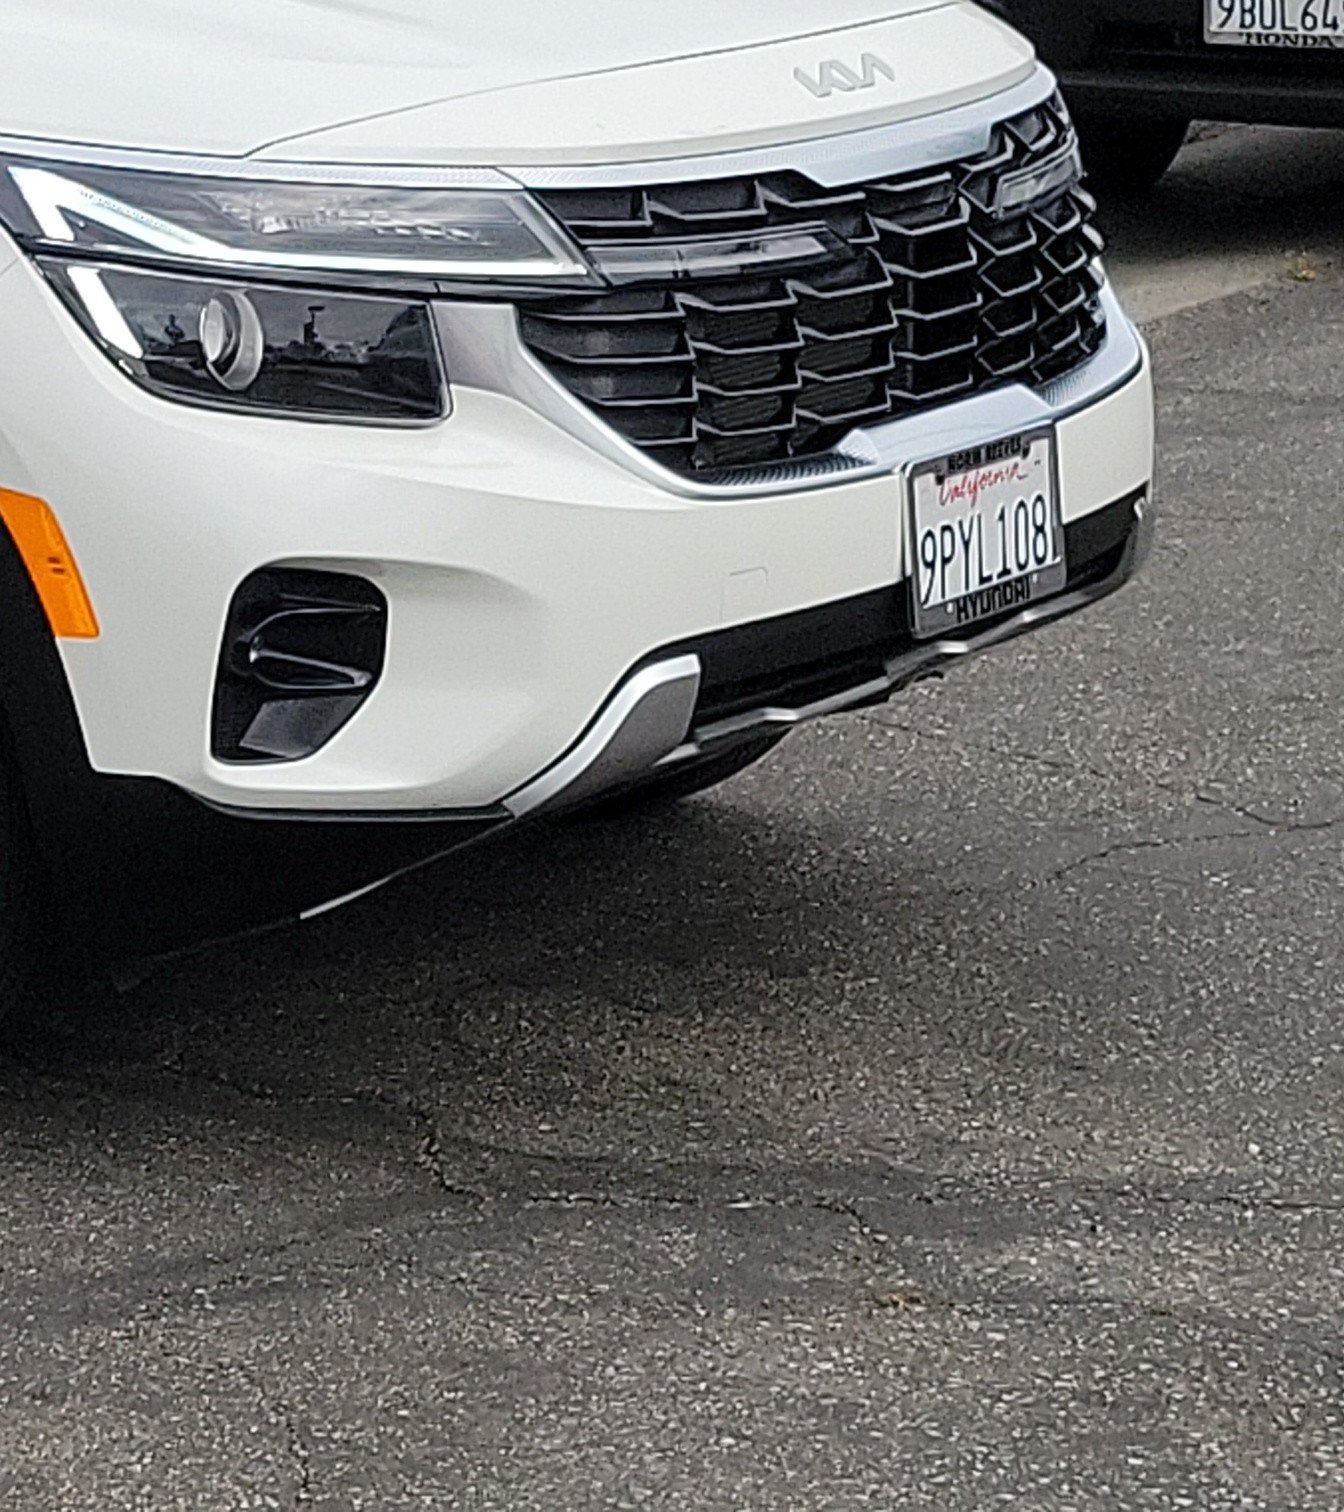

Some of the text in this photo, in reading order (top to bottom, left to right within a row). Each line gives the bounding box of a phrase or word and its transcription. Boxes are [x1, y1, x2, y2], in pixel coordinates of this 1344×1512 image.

[1245, 32, 1338, 48] HONDA
[793, 52, 895, 97] KIA
[939, 461, 1029, 507] California
[920, 494, 1049, 607] 9PYL108
[956, 575, 1032, 624] HYUNDAI
